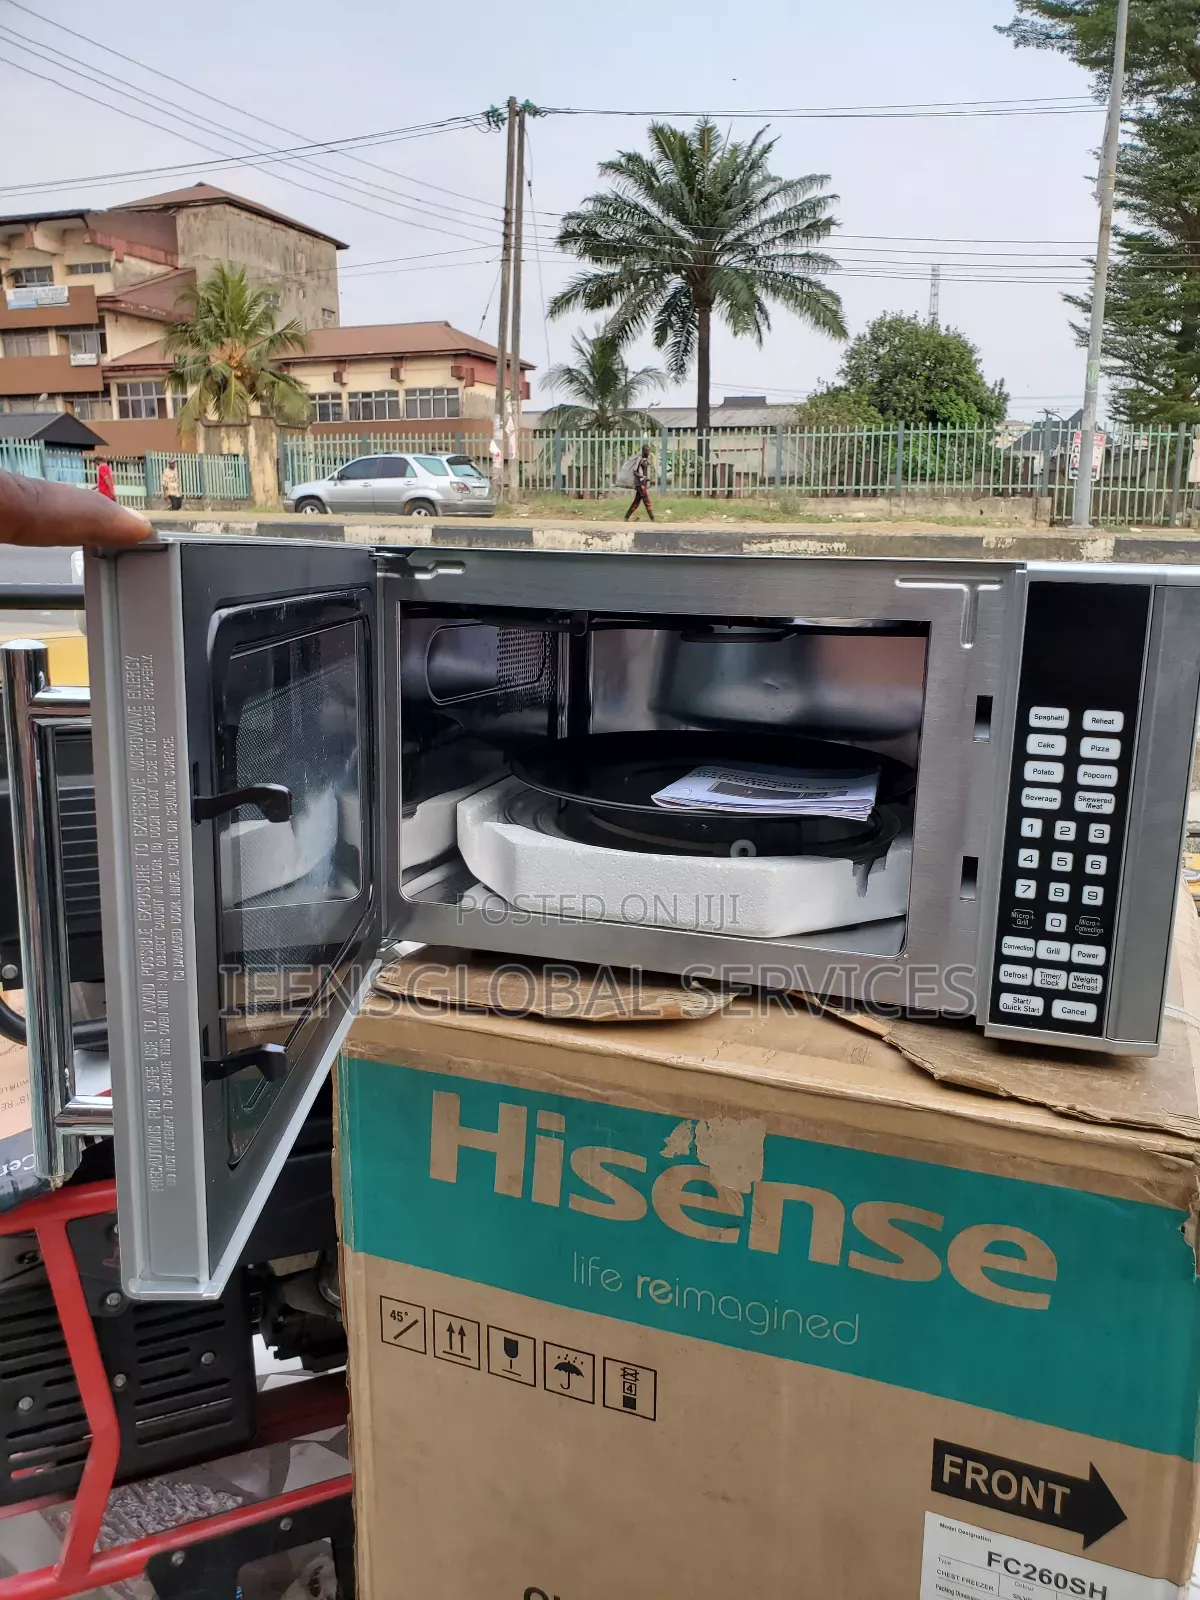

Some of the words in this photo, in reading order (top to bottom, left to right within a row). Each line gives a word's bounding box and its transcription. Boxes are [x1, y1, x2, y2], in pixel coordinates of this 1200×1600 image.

[124, 654, 142, 700] ENERGY
[143, 705, 156, 733] CLOSE
[1034, 713, 1065, 723] Spaghetti
[1091, 717, 1115, 726] Reheat
[126, 705, 145, 772] MICROWAVE
[145, 738, 157, 756] NOT
[1037, 741, 1055, 749] Cake
[1090, 744, 1110, 753] Pizza
[1032, 768, 1055, 776] Potato
[1082, 771, 1112, 780] Popcorn
[147, 788, 159, 809] THAT
[1025, 793, 1058, 803] Beverage
[1077, 795, 1113, 804] Skewered
[130, 777, 148, 838] EXCESSIVE
[1085, 802, 1103, 810] Meat
[149, 815, 161, 838] DOOR
[1026, 824, 1033, 833] 1
[1060, 826, 1071, 836] 2
[1093, 829, 1105, 839] 3
[134, 842, 150, 858] TO
[1022, 854, 1034, 864] 4
[1056, 857, 1067, 867] 5
[1090, 860, 1101, 870] 6
[135, 864, 152, 922] EXPOSURE
[152, 885, 164, 894] IN
[1020, 884, 1031, 894] 7
[1053, 887, 1064, 897] 8
[1087, 891, 1098, 901] 9
[152, 898, 165, 931] CAUGHT
[1016, 918, 1029, 926] Grill
[1050, 918, 1062, 928] 0
[1074, 925, 1104, 934] Convection
[138, 928, 155, 977] POSSIBLE
[154, 936, 167, 967] OBJECT
[171, 928, 184, 967] DAMAGED
[1003, 942, 1034, 953] Convection
[1046, 947, 1061, 956] Grill
[1077, 951, 1099, 960] Power
[1003, 970, 1028, 980] Defrost
[1039, 971, 1062, 980] Timer/
[1073, 975, 1098, 985] Weight
[1040, 978, 1059, 987] Clock
[1071, 983, 1098, 992] Defrost
[141, 983, 157, 1014] AVOID
[1012, 997, 1032, 1005] Start/
[1002, 1003, 1022, 1012] Quick
[1023, 1004, 1040, 1013] Start
[1061, 1006, 1087, 1016] Cancel
[142, 1020, 158, 1035] TO
[158, 1011, 170, 1035] OVEN
[143, 1041, 159, 1061] USE
[160, 1038, 171, 1056] THIS
[144, 1066, 160, 1093] SAFE
[160, 1060, 173, 1096] OPERATE
[147, 1099, 162, 1120] FOR
[161, 1099, 174, 1111] TO
[162, 1114, 175, 1152] ATTEMPT
[148, 1124, 164, 1192] PRECAUTIONS
[164, 1153, 176, 1172] NOT
[428, 1089, 1058, 1311] Hisense
[571, 1251, 623, 1293] life
[635, 1275, 861, 1348] reimagined
[942, 1453, 1071, 1516] FRONT
[939, 1522, 957, 1533] Model
[957, 1528, 992, 1543] Designation
[937, 1557, 952, 1567] Type
[936, 1569, 960, 1581] CHEST
[961, 1575, 995, 1592] FREEZER
[987, 1551, 1108, 1600] FC260SH
[1014, 1581, 1035, 1592] Colour
